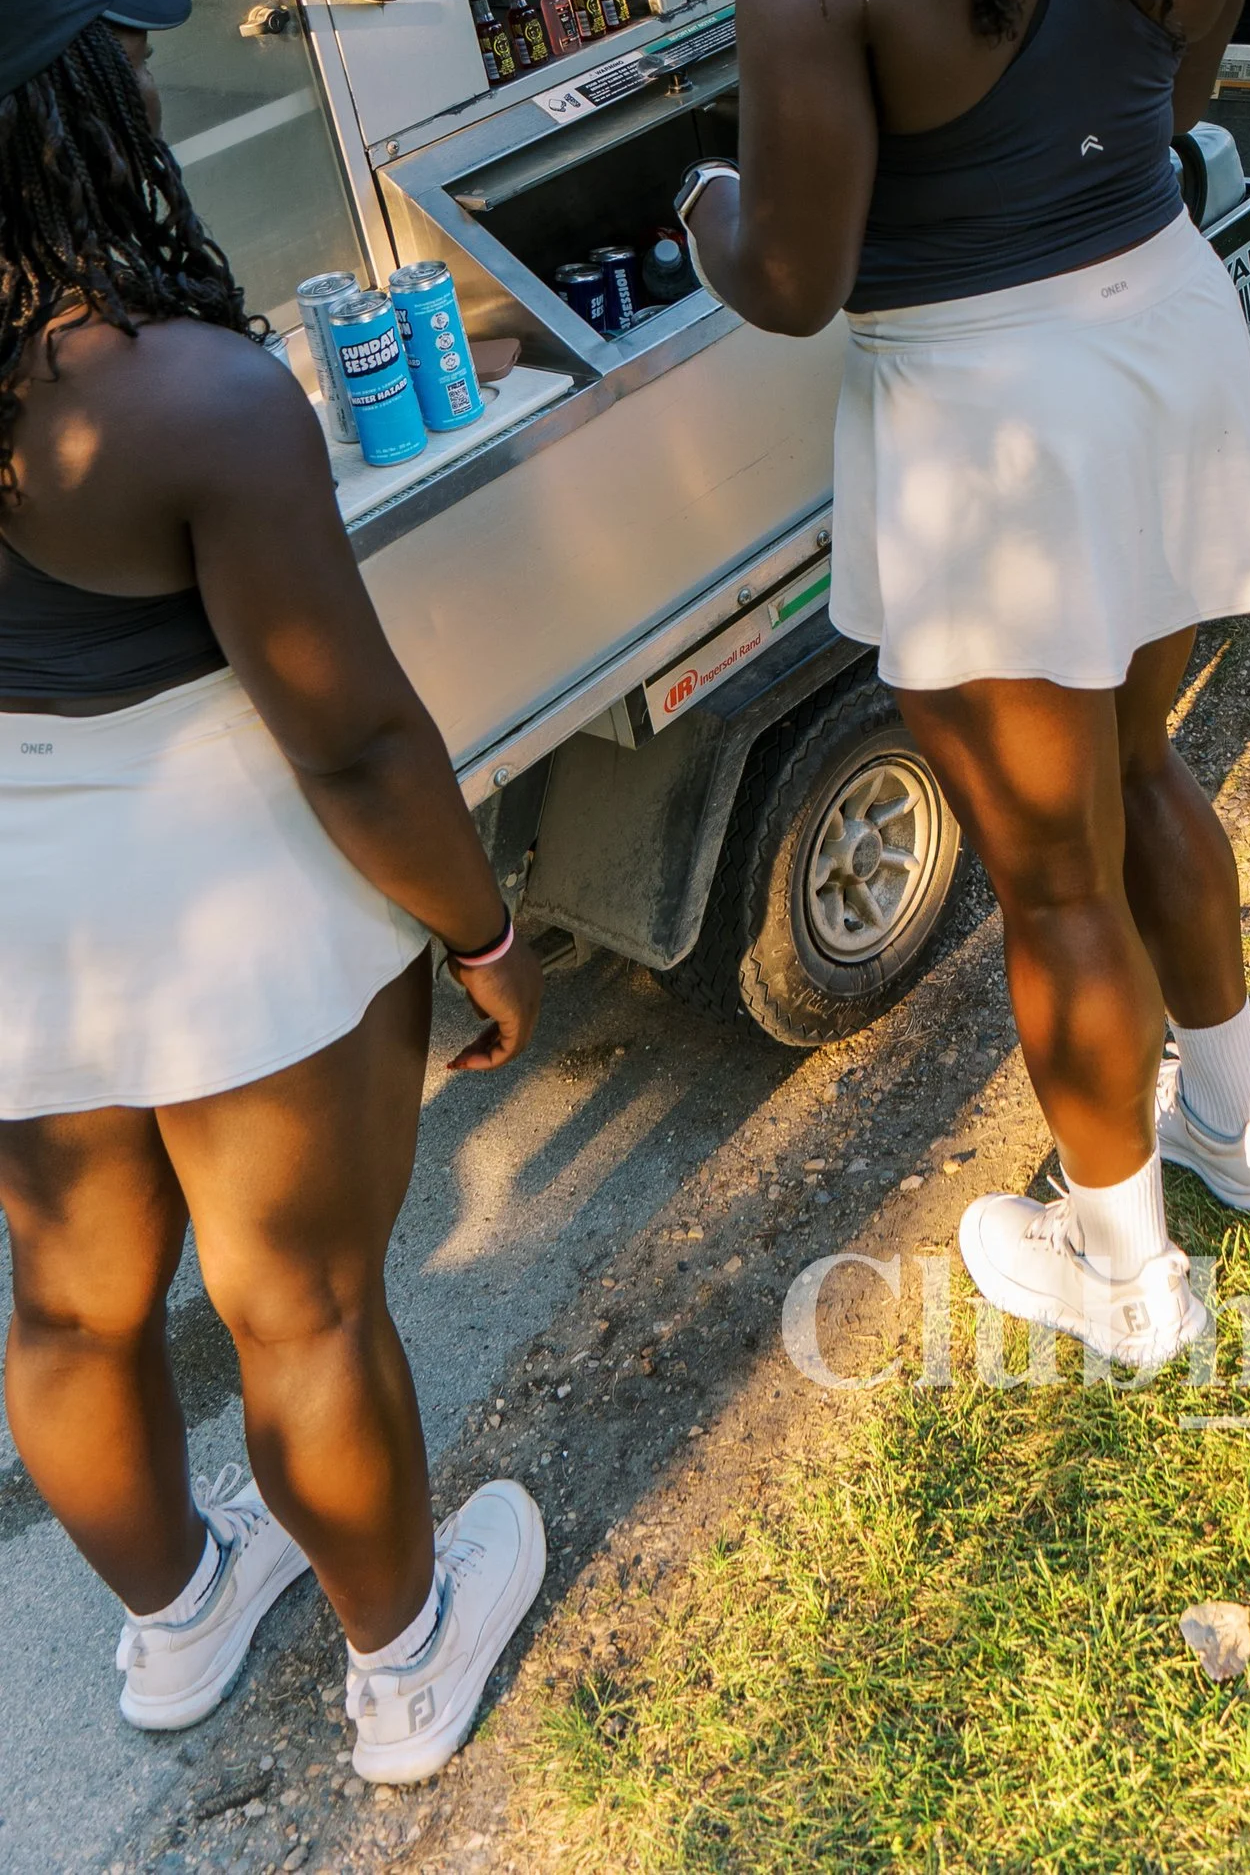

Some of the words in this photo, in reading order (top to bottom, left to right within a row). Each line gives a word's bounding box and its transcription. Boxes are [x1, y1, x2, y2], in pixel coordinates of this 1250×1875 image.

[595, 60, 624, 76] WARNING
[1101, 280, 1129, 299] ONER
[341, 326, 395, 361] SUNDAY
[345, 341, 399, 374] SESSION
[352, 394, 377, 405] WATER
[377, 377, 408, 401] HAZARD
[700, 649, 738, 686] Ingersoll
[739, 633, 762, 656] Rand
[670, 675, 693, 708] IR
[20, 742, 54, 755] ONER
[408, 1685, 436, 1734] FJ
